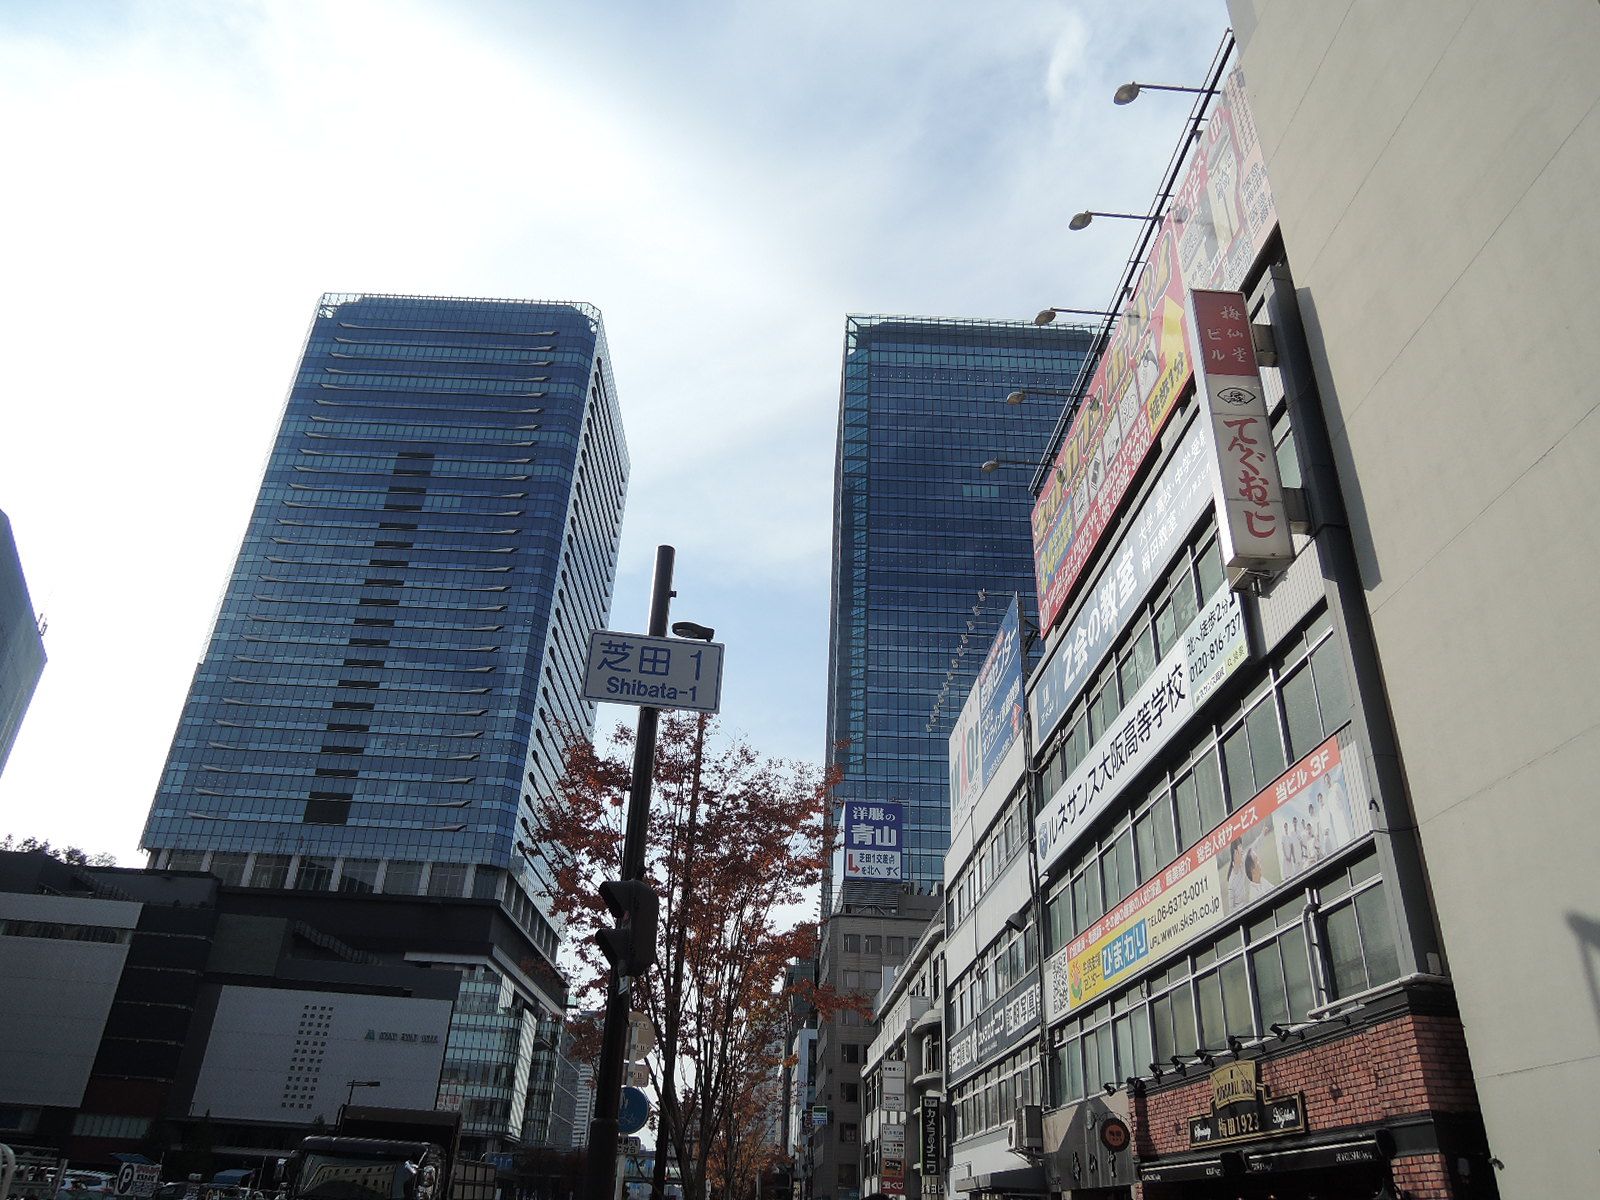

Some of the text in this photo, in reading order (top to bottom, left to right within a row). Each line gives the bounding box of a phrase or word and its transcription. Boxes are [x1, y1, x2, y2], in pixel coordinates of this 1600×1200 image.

[1207, 328, 1225, 361] ビル
[1063, 547, 1137, 692] Z会の教室
[597, 640, 703, 681] 芝田 1
[1189, 610, 1241, 683] 0120-816-737
[606, 676, 699, 702] Shibata-1
[1049, 663, 1186, 847] ルネサンス大阪高等学校
[1275, 771, 1308, 805] 当ビル
[1310, 749, 1330, 777] 3F
[852, 806, 896, 822] 洋服の
[851, 823, 897, 847] 青山
[859, 853, 895, 865] 芝田1交差点
[861, 865, 881, 876] を北へ
[1104, 923, 1148, 974] ひまわり
[1218, 1113, 1260, 1138] 梅田1923
